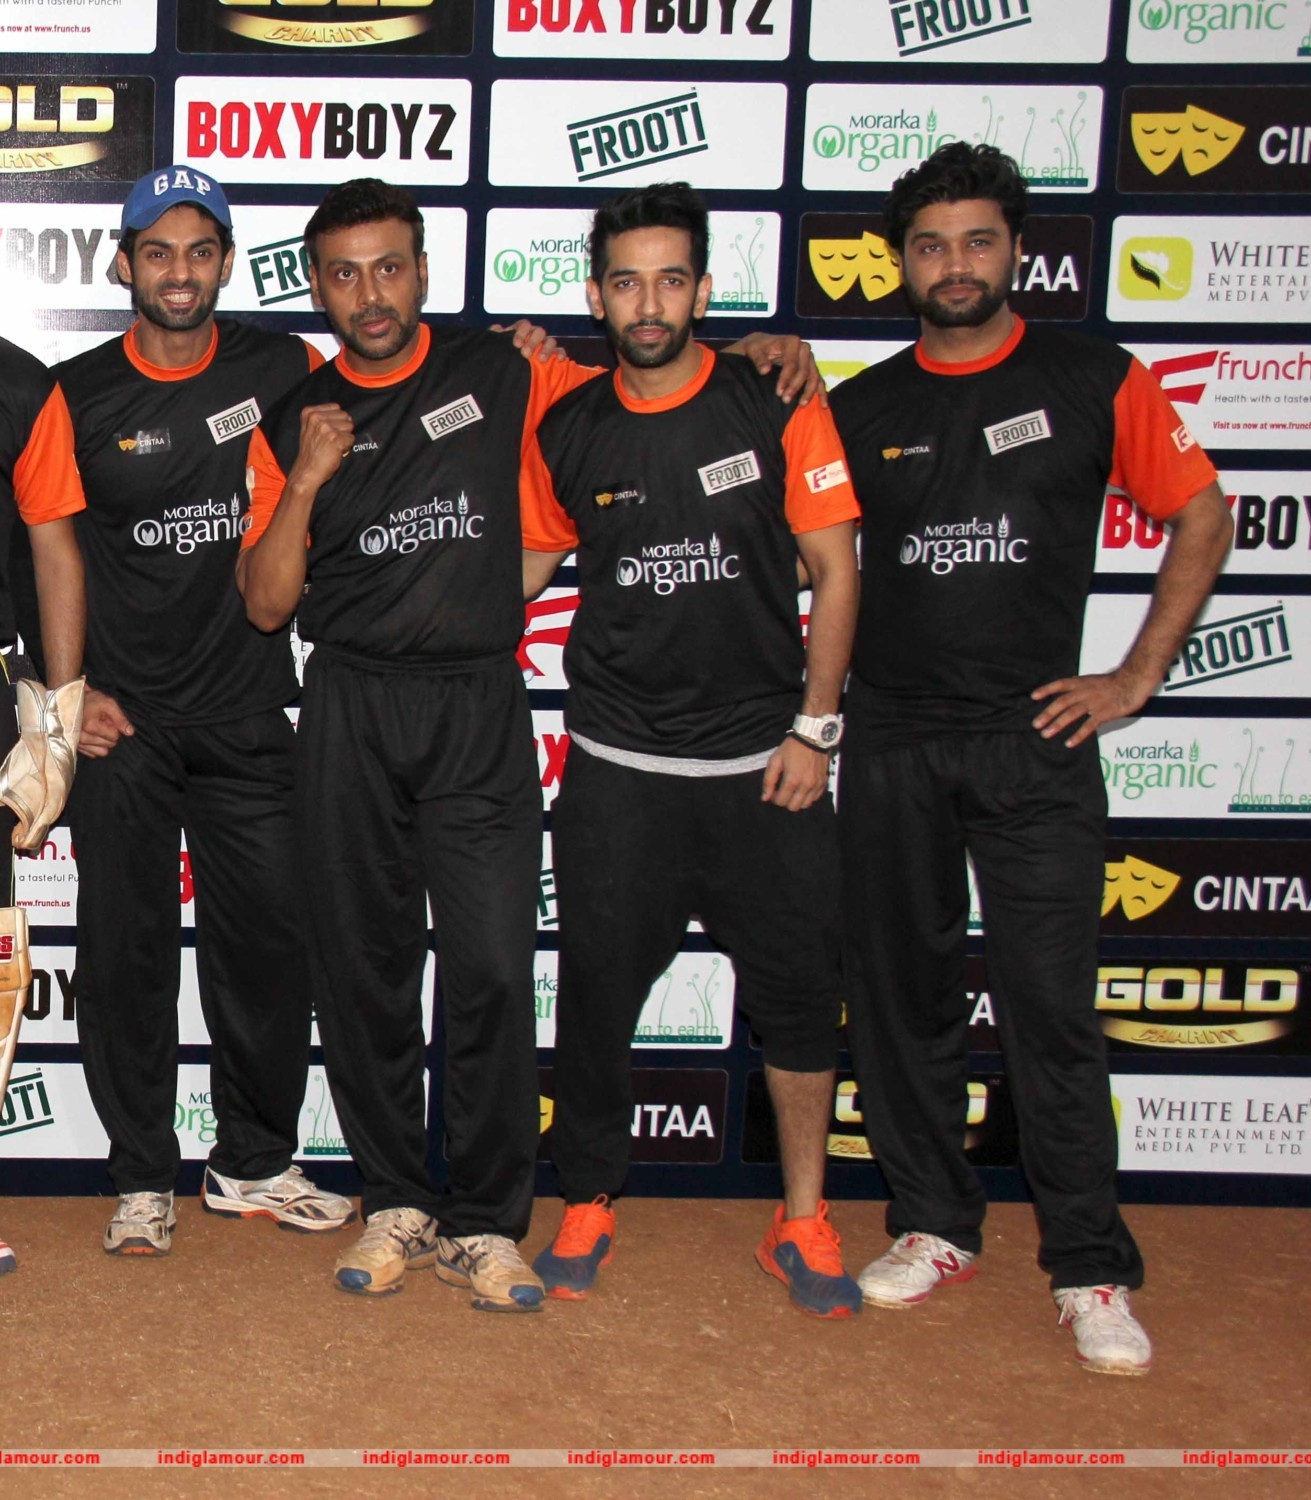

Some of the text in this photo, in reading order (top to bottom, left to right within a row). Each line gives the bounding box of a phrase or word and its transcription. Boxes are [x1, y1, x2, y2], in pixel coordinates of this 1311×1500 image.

[6, 25, 23, 33] now
[24, 25, 32, 33] at
[34, 24, 91, 33] www.frunch.us
[264, 26, 383, 43] CHARITY
[849, 108, 921, 130] Morarka
[187, 101, 457, 161] BOXYBOYZ
[568, 100, 706, 173] FROOTI
[1041, 163, 1085, 179] earth
[153, 170, 212, 197] GAP
[1208, 289, 1269, 301] MEDIA
[1214, 393, 1281, 404] Health with a
[214, 408, 257, 438] FROOTI
[429, 402, 476, 434] FROOTI
[1212, 420, 1269, 431] Visit us now at
[138, 437, 165, 447] CINTAA
[991, 418, 1044, 448] FROOTI
[352, 441, 379, 453] CINTAA
[903, 445, 930, 456] CINTAA
[705, 459, 755, 488] FROOTI
[613, 488, 639, 501] CINTAA
[162, 498, 227, 520] Morarka
[389, 496, 454, 525] Morarka
[359, 511, 485, 556] Organic
[924, 517, 993, 539] Morarka
[641, 537, 705, 559] Morarka
[899, 536, 1029, 575] Organic
[616, 554, 740, 596] Organic
[1114, 740, 1184, 760] Morarka
[28, 874, 66, 882] tasteful
[16, 900, 71, 908] www.frunch.us
[1193, 875, 1311, 912] CINTA
[1094, 967, 1300, 1012] GOLD
[1136, 1096, 1309, 1123] WHITE LEAF
[1135, 1125, 1305, 1141] ENTERTAINMENT
[1135, 1141, 1303, 1156] MEDIA PVT. LTD.
